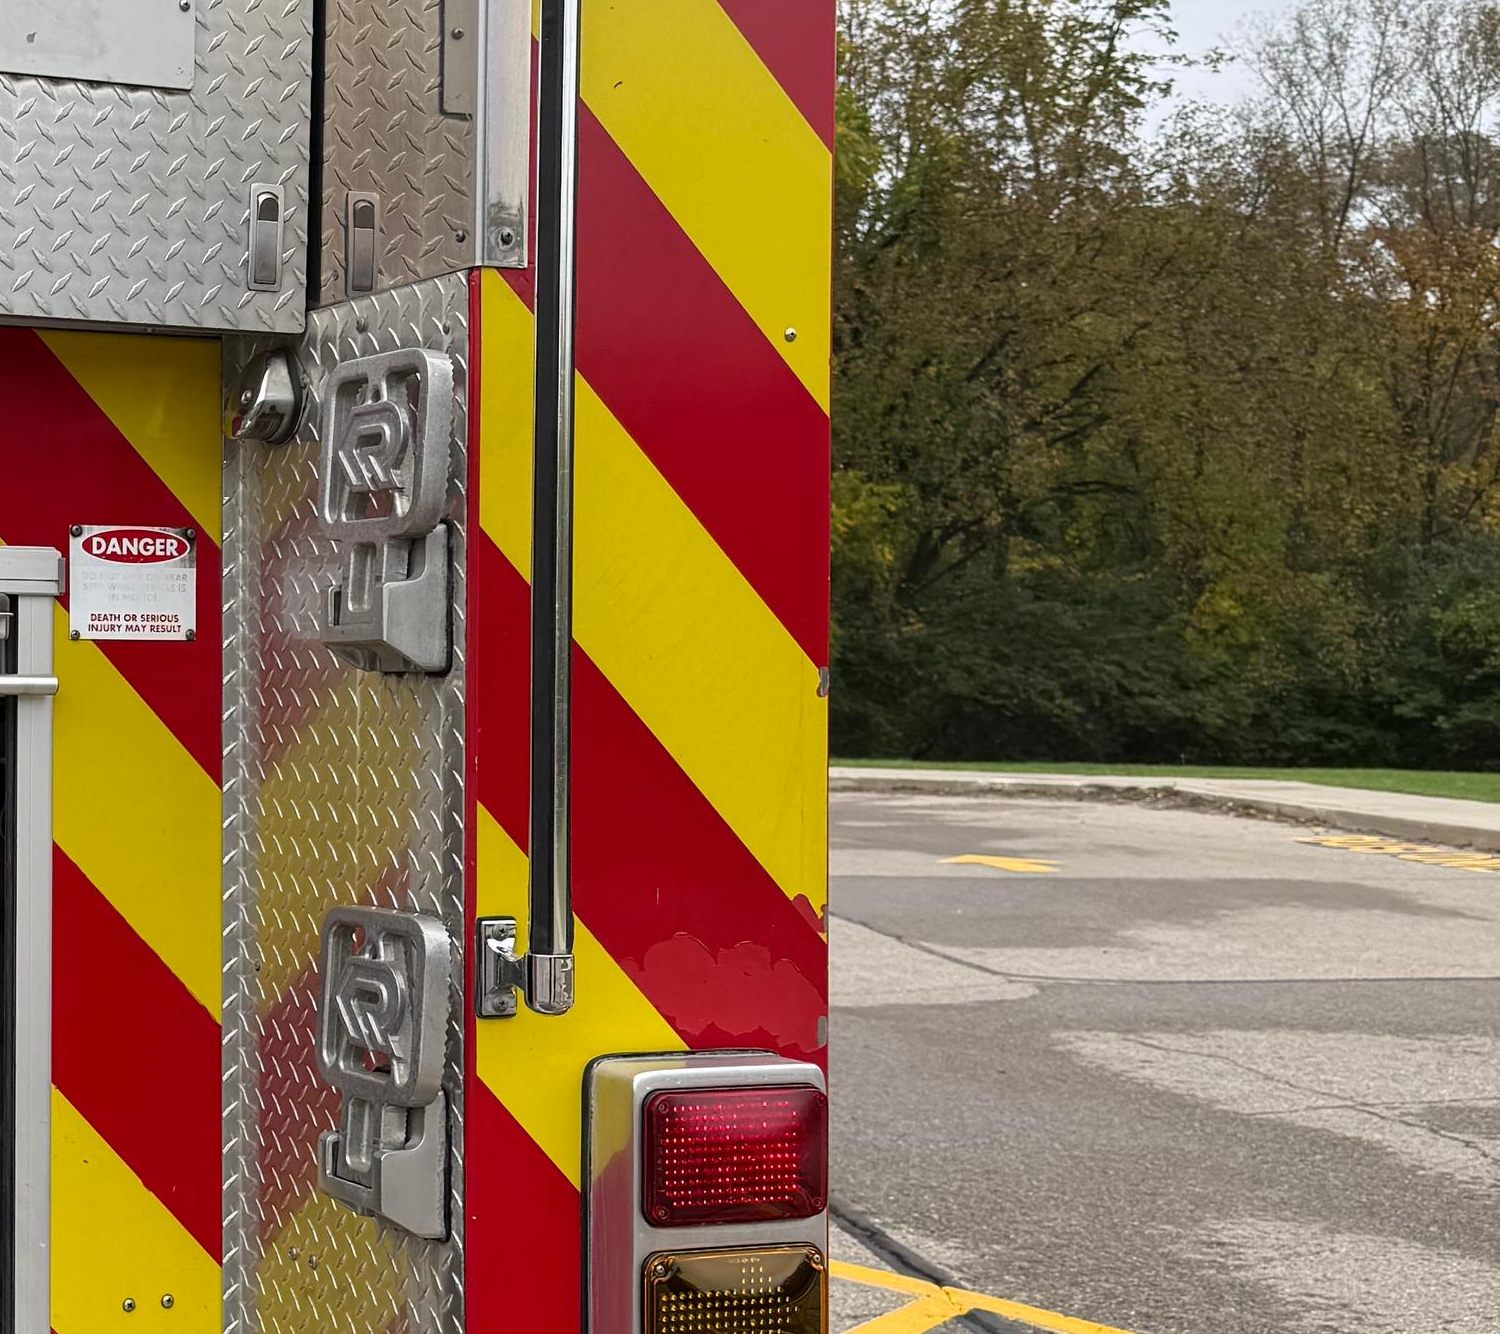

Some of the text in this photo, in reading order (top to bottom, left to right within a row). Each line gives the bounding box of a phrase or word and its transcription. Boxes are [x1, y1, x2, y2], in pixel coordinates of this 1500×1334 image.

[92, 537, 179, 557] DANGER
[90, 613, 180, 623] DEATH OR SERIOUS
[88, 624, 182, 633] INJURY MAY RESULT
